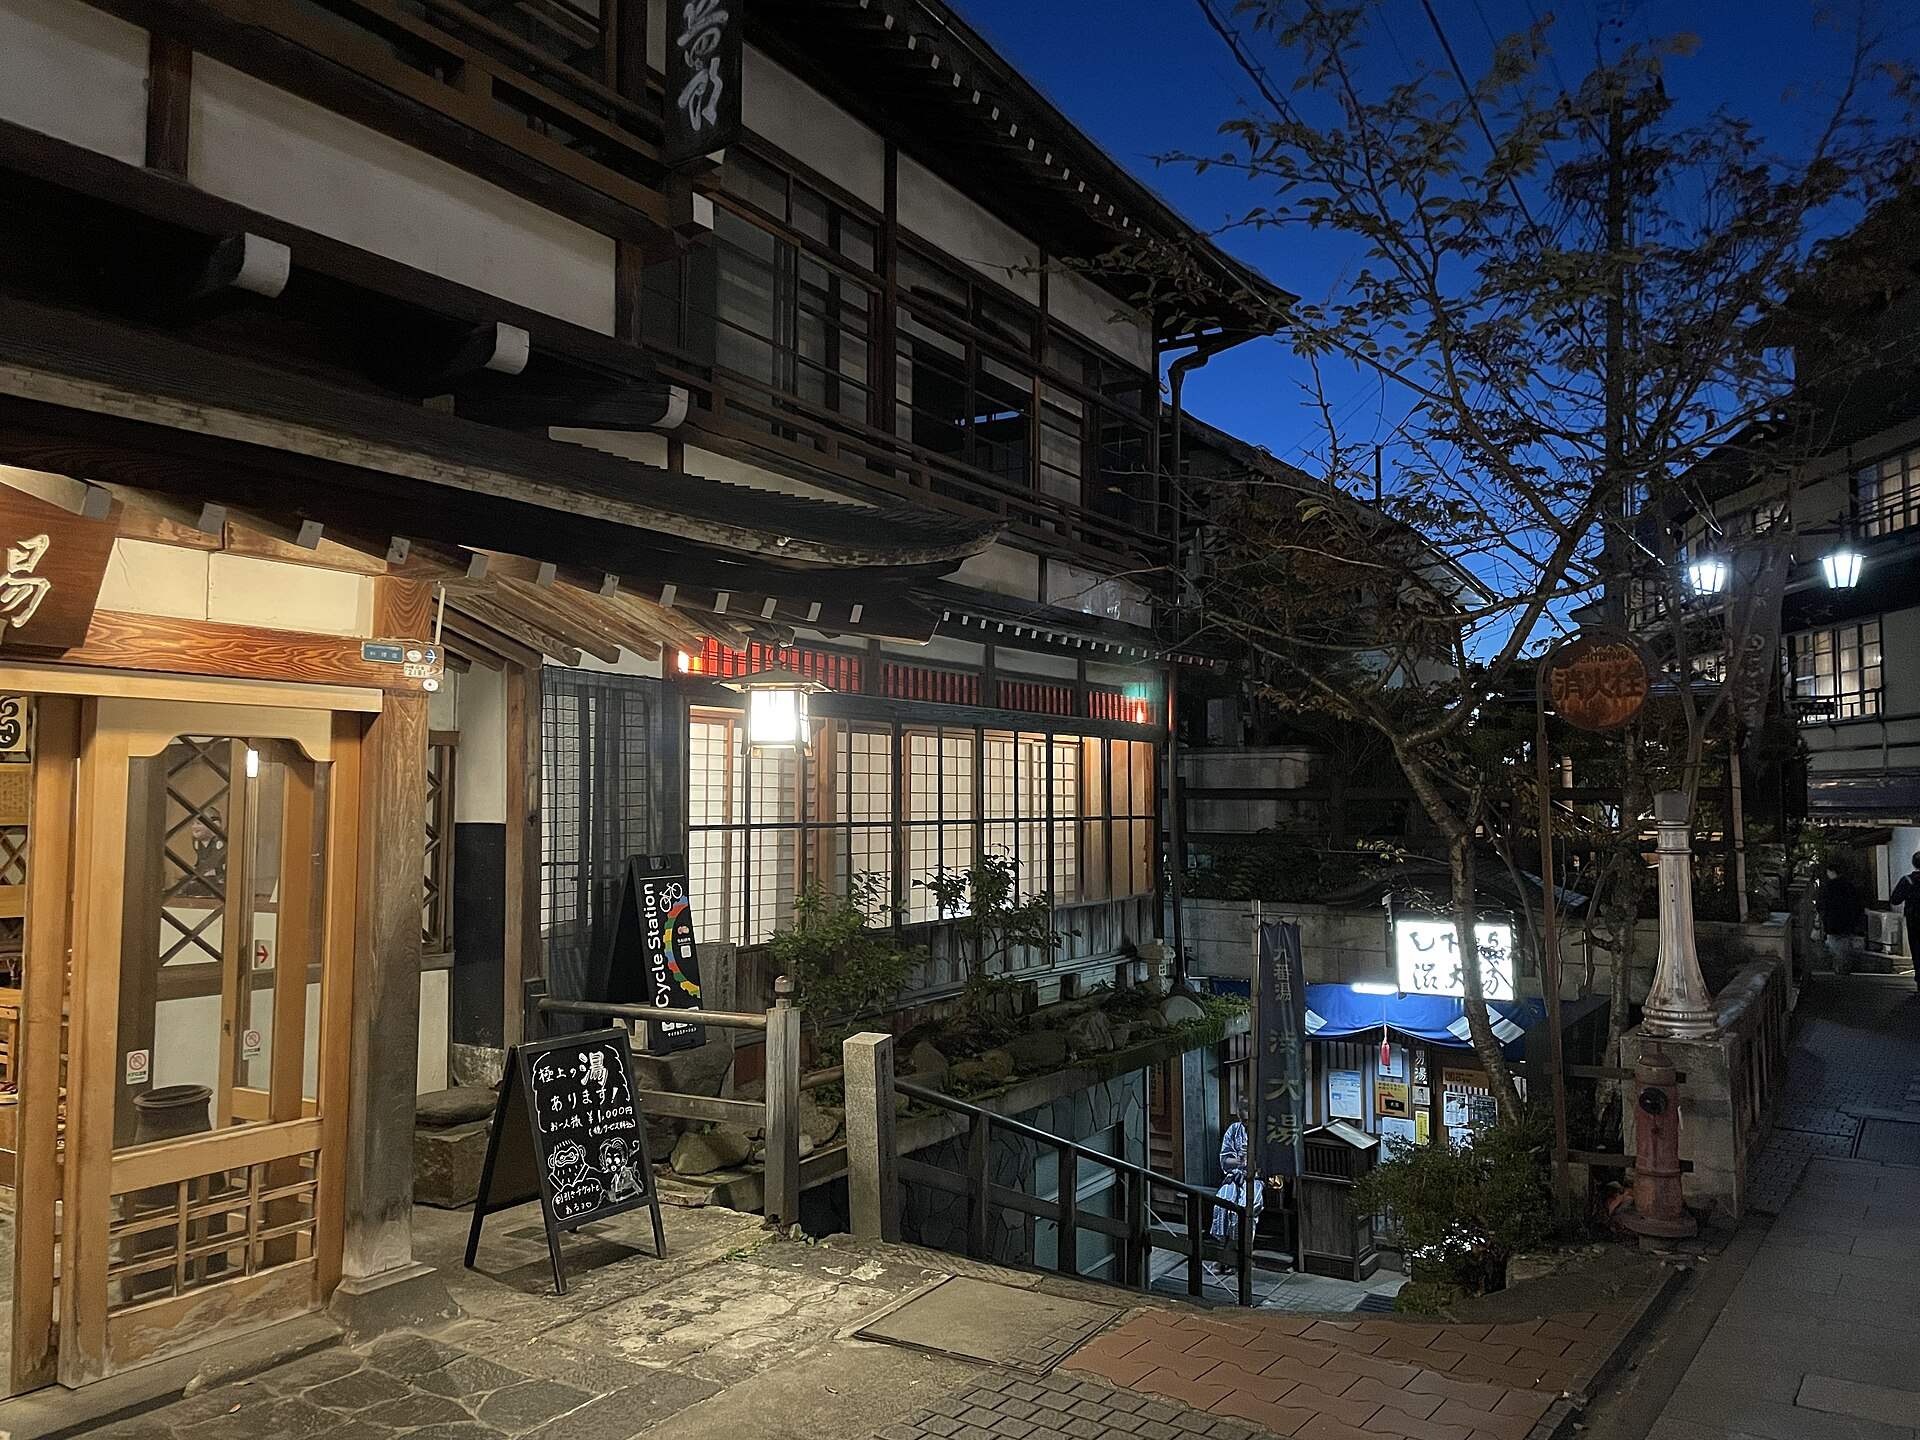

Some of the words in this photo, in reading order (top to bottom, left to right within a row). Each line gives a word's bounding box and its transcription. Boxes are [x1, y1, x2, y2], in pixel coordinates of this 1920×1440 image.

[643, 883, 661, 949] Station
[652, 953, 672, 1008] Cycle
[538, 1050, 608, 1086] 極上の湯
